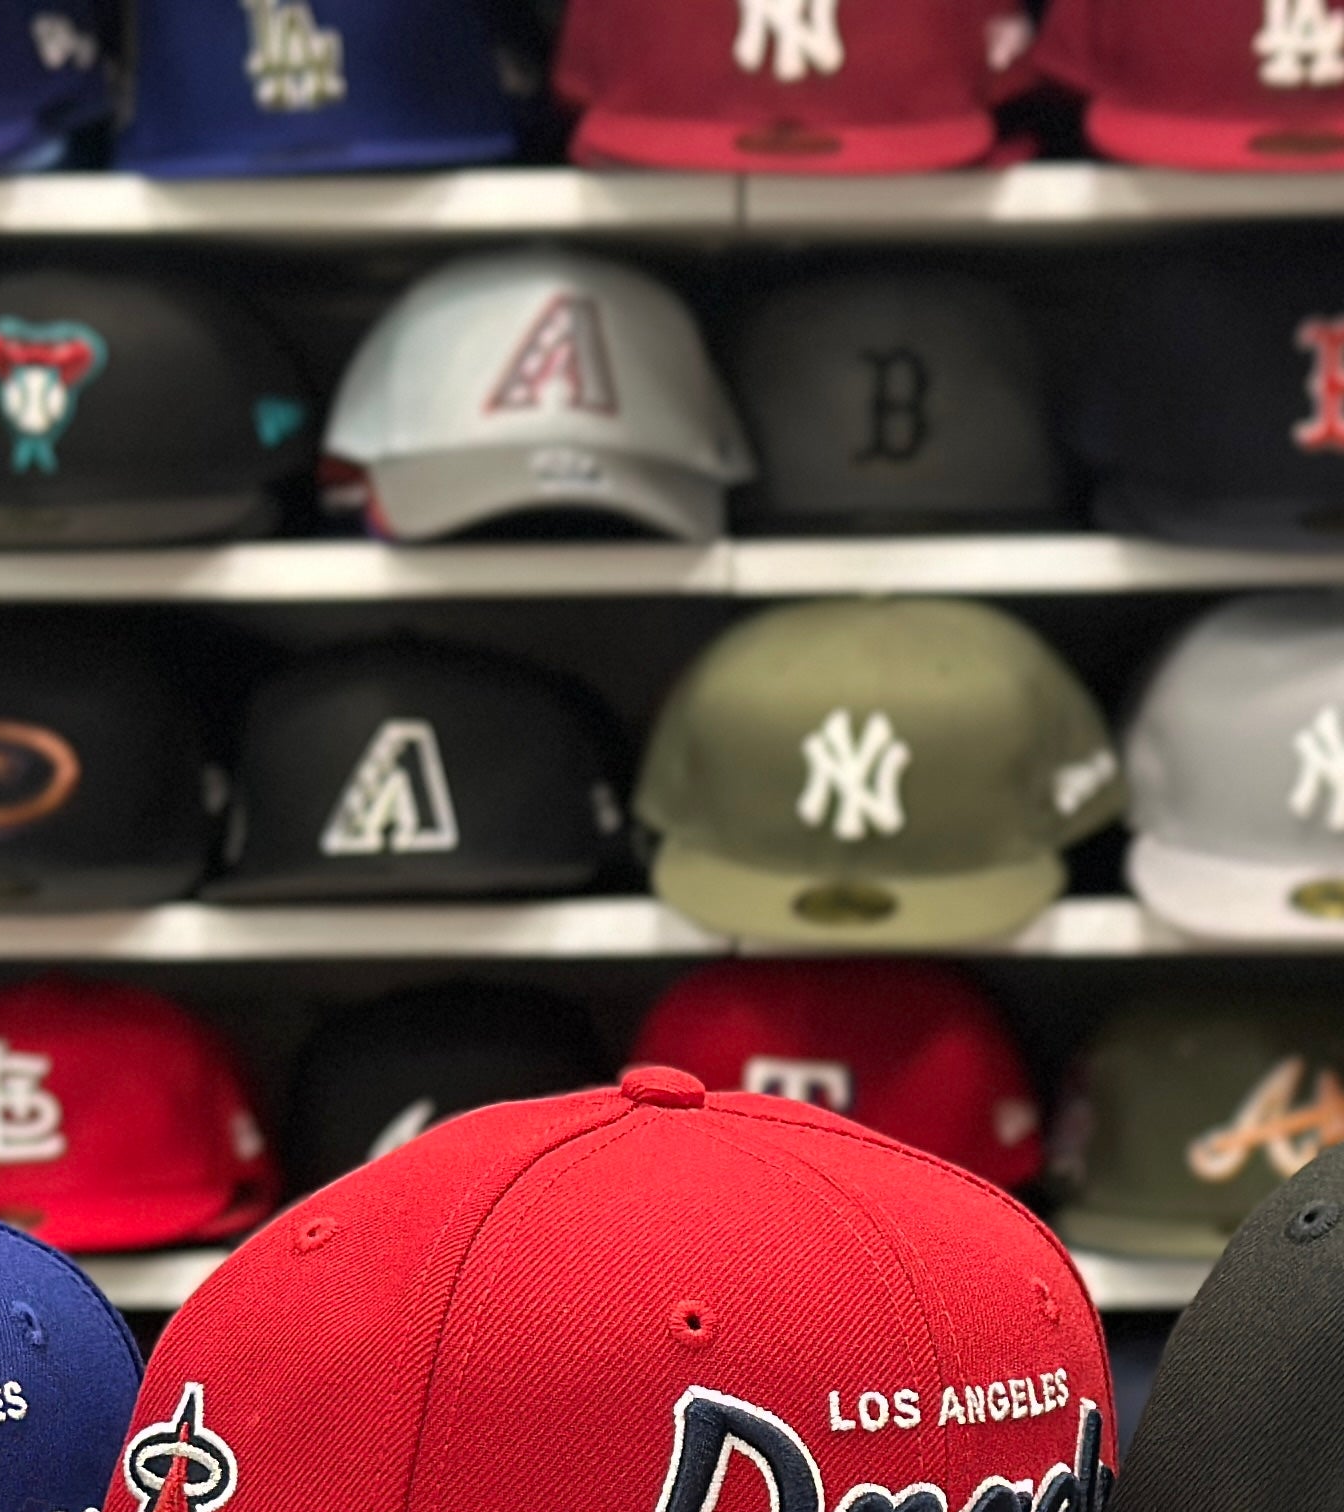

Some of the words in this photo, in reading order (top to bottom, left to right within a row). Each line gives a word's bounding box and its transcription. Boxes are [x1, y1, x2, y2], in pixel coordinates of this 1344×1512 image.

[483, 283, 621, 417] A
[856, 348, 930, 465] B
[321, 718, 460, 855] A
[796, 708, 910, 840] NY
[829, 1386, 921, 1432] LOS
[936, 1366, 1071, 1427] ANGELES
